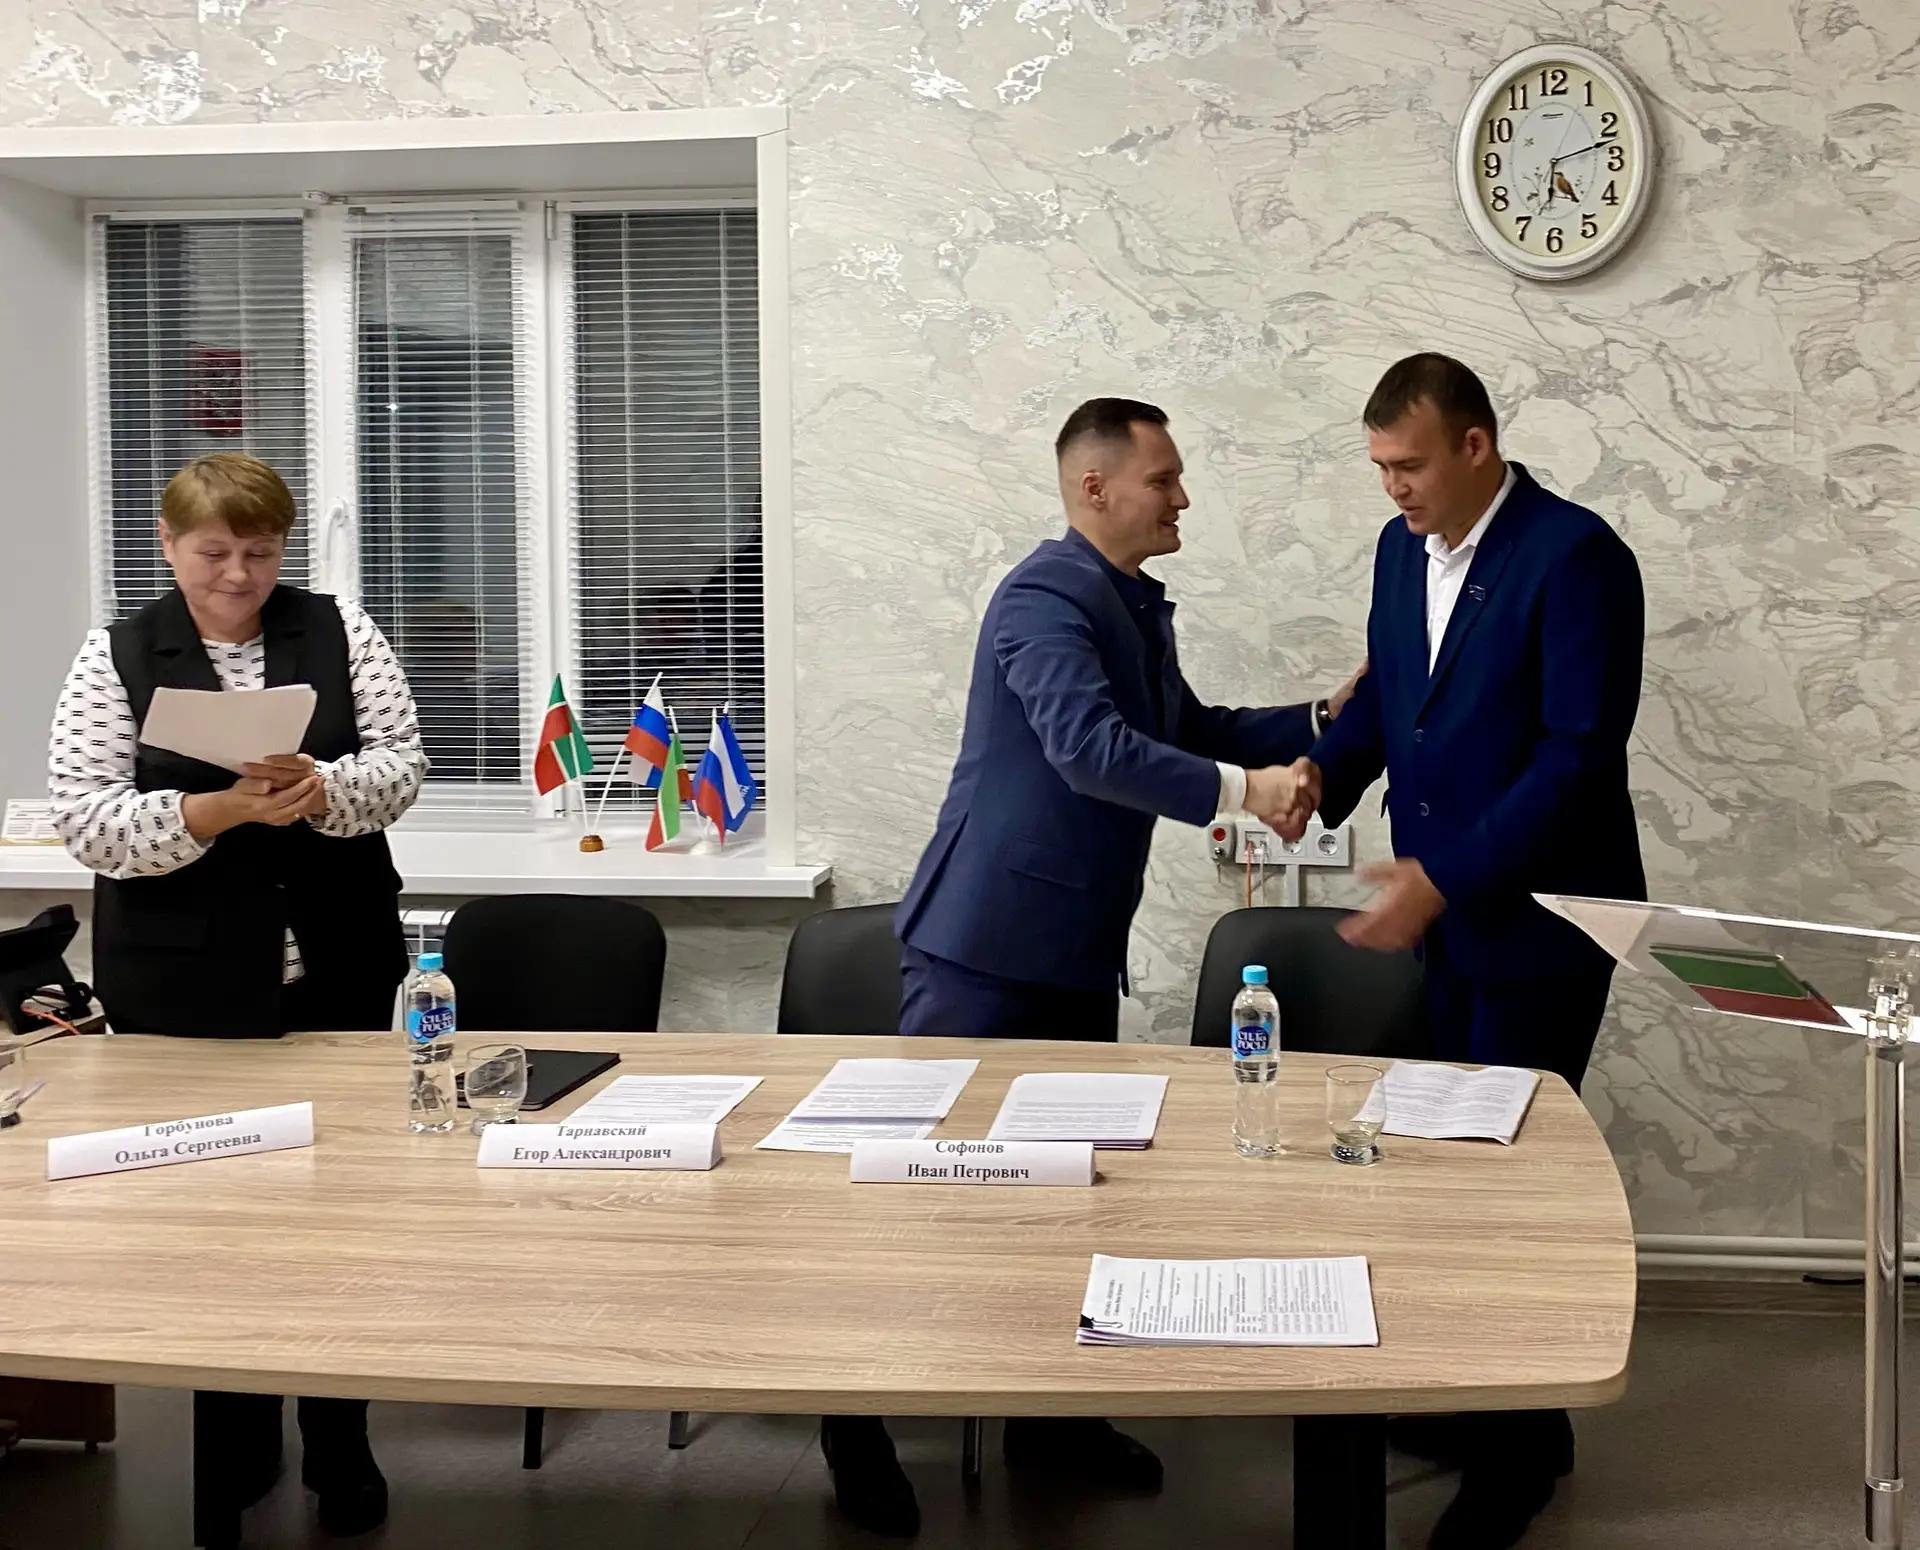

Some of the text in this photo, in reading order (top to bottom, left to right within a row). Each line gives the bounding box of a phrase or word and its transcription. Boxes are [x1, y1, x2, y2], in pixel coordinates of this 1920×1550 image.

[1539, 69, 1568, 97] 12
[1583, 80, 1594, 107] 1
[1508, 83, 1530, 111] 11
[1487, 117, 1513, 144] 10
[1600, 112, 1618, 138] 2
[1483, 152, 1501, 178] 9
[1607, 145, 1625, 172] 3
[1490, 186, 1509, 212] 8
[1601, 180, 1619, 206] 4
[1515, 215, 1533, 242] 7
[1580, 213, 1598, 239] 5
[1546, 227, 1564, 253] 6
[144, 1116, 234, 1137] Горбунова
[115, 1133, 262, 1164] Ольга Сергеевна
[512, 1147, 672, 1164] Егор Александрович
[935, 1140, 1005, 1157] Софонов
[907, 1163, 1030, 1182] Иван Петрович
